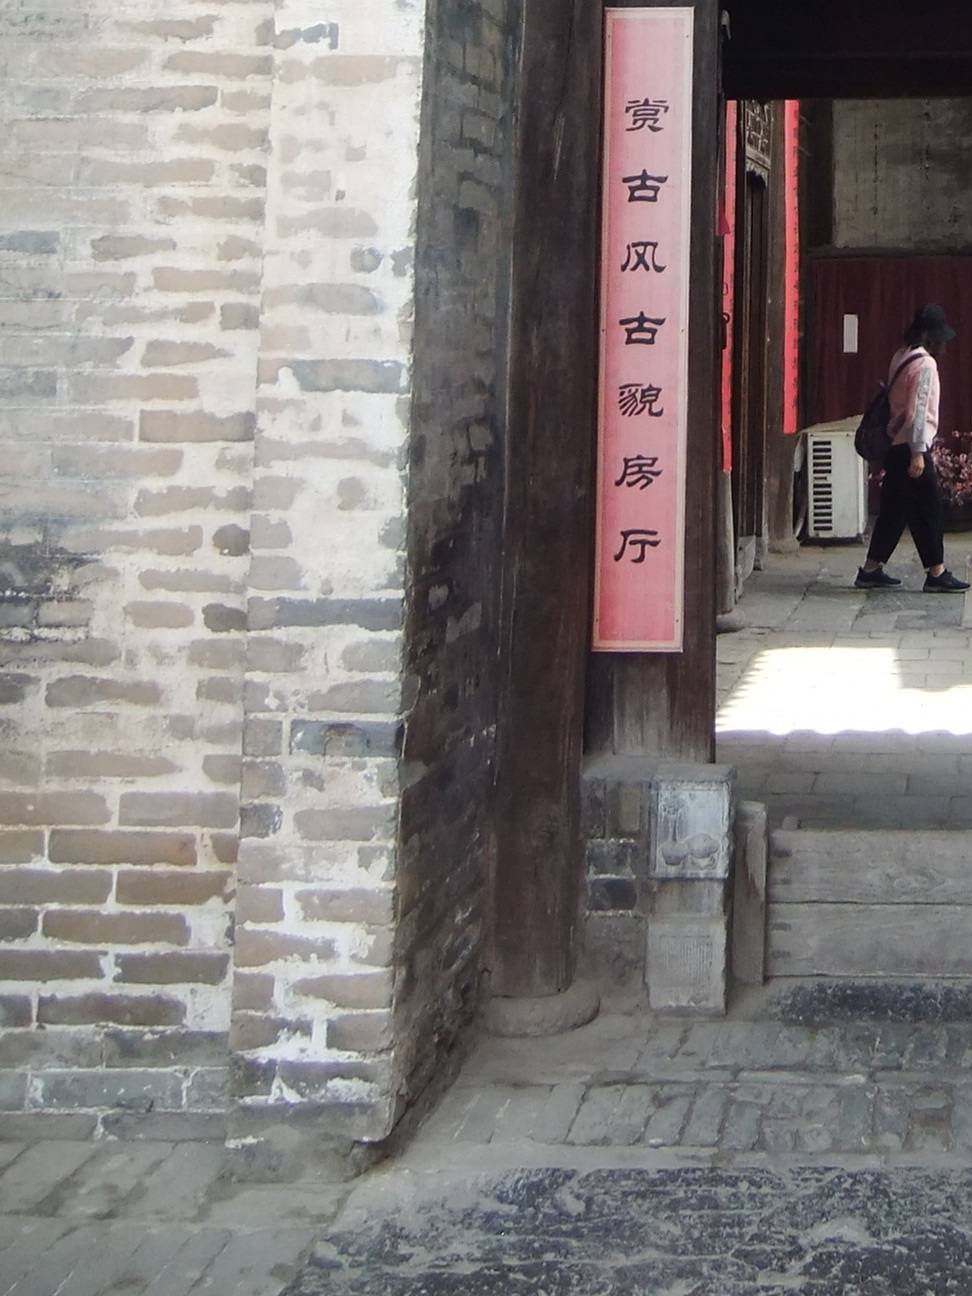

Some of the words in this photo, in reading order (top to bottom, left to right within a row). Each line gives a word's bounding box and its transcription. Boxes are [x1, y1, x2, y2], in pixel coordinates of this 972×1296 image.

[613, 98, 669, 564] 赏古风古貌房厅
